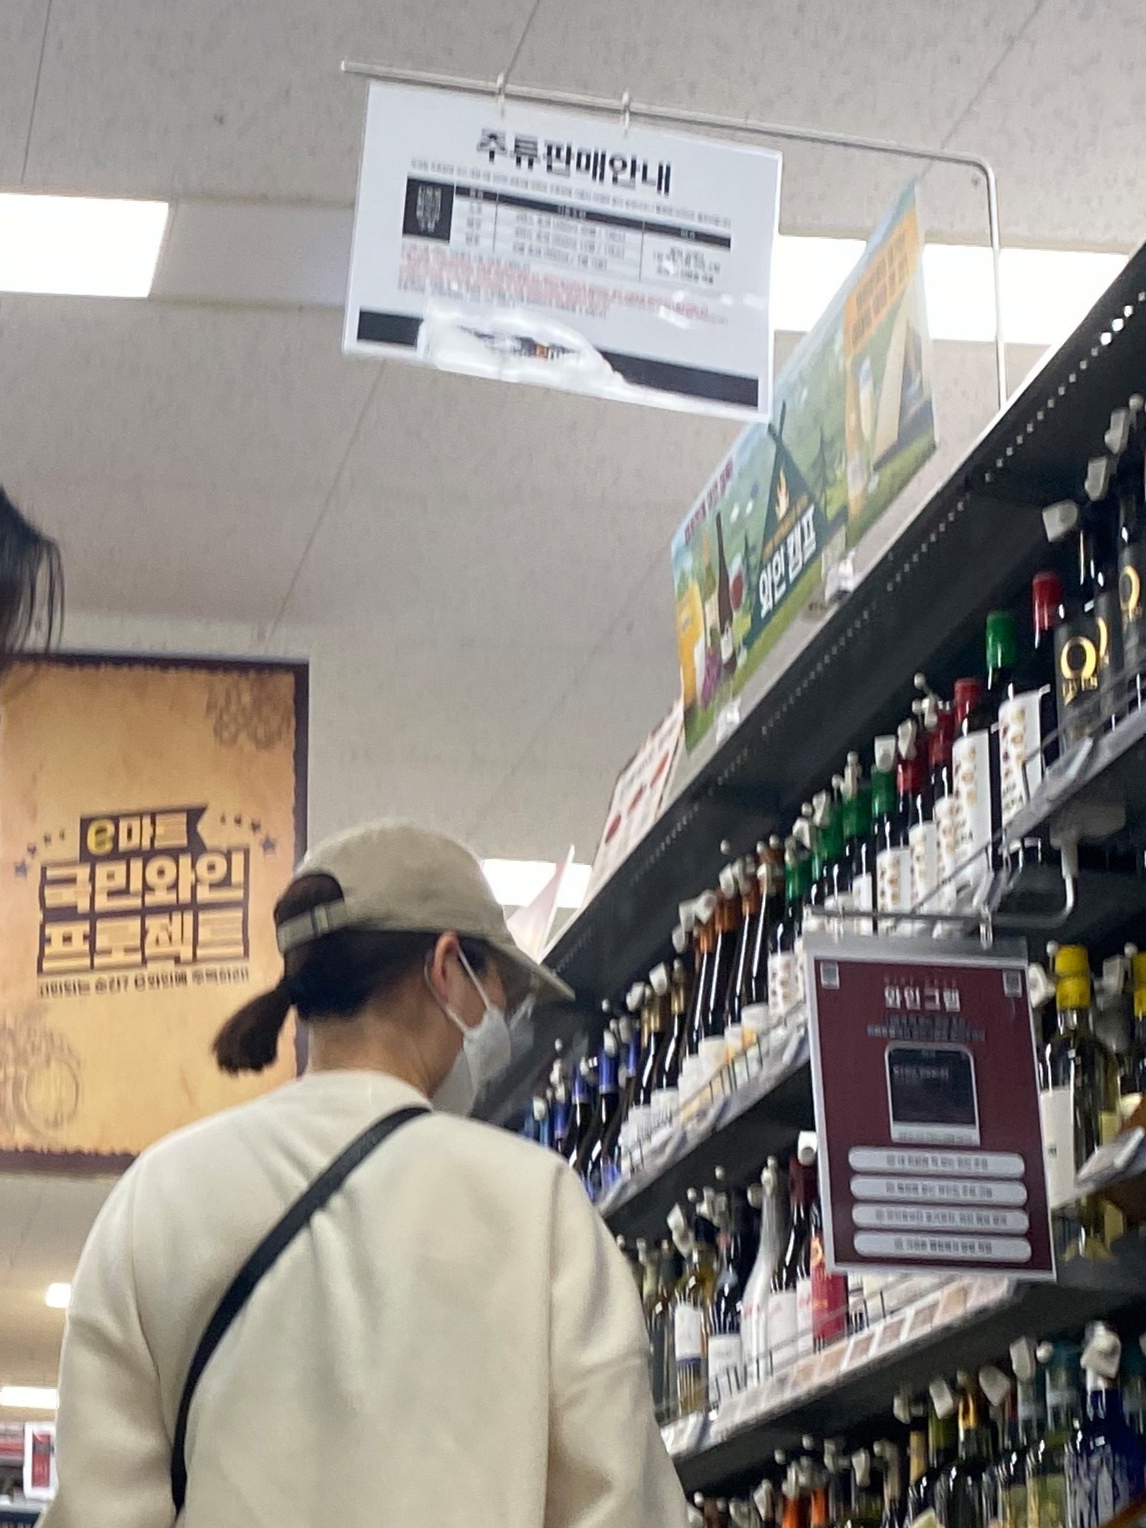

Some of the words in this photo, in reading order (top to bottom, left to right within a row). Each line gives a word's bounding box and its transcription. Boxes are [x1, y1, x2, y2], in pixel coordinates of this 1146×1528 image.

[476, 128, 672, 197] 주류판매안내
[86, 812, 188, 856] e마트
[42, 848, 246, 913] 국민와인
[42, 908, 246, 972] 프로젝트
